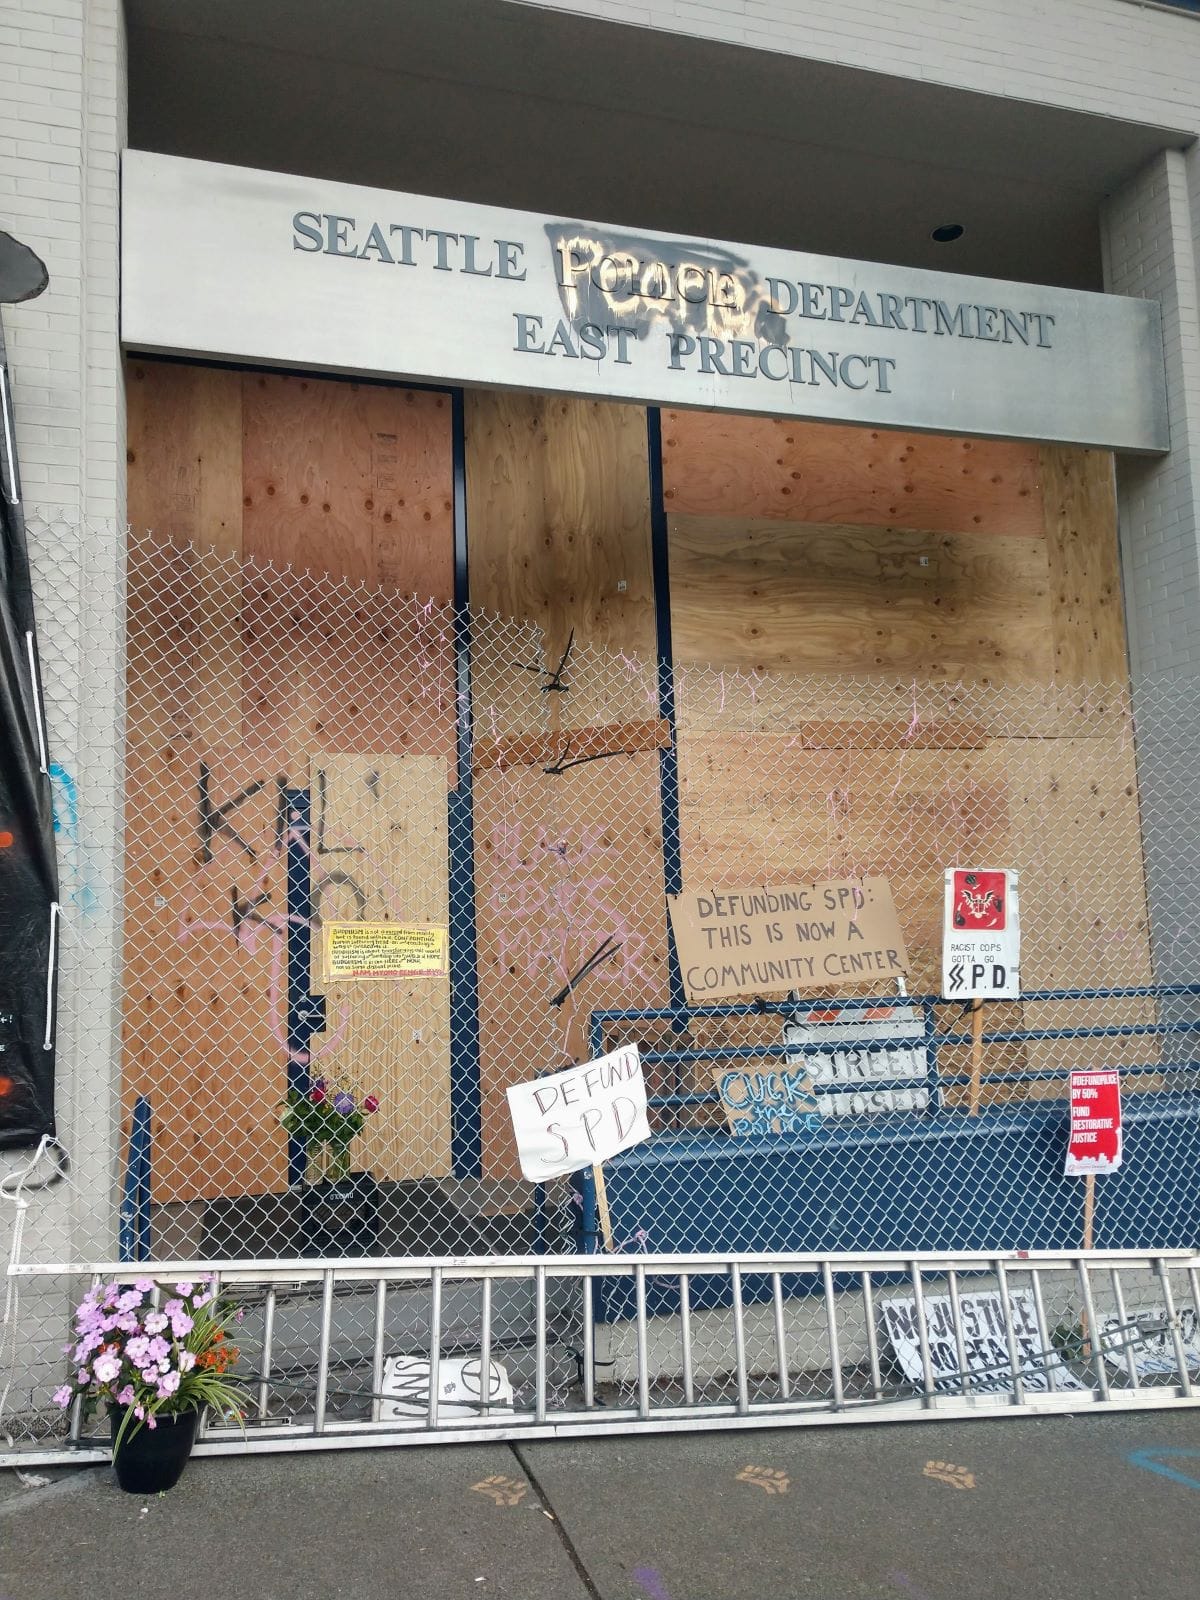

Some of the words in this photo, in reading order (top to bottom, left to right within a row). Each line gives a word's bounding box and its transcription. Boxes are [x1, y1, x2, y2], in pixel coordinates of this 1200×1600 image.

[293, 211, 528, 281] SEATTLE
[765, 277, 1056, 349] DEPARTMENT
[512, 312, 638, 365] EAST
[667, 333, 896, 394] PRECINCT
[696, 891, 813, 918] DEFUNDING
[823, 887, 875, 910] SPD:
[701, 923, 752, 949] THIS
[766, 922, 784, 943] IS
[796, 921, 835, 942] NOW
[847, 921, 864, 941] A
[950, 943, 976, 952] RACIST
[979, 943, 1002, 952] COPS
[686, 956, 815, 991] COMMUNITY
[823, 949, 902, 976] CENTER
[951, 955, 976, 963] GOTTA
[984, 955, 995, 963] GO
[533, 1052, 639, 1116] DEFUND
[1072, 1088, 1081, 1099] BY
[1082, 1087, 1098, 1099] 50%
[1073, 1106, 1090, 1117] FUND
[1073, 1118, 1114, 1130] RESTORATIVE
[540, 1096, 638, 1164] SPD
[1072, 1131, 1098, 1143] JUSTICE
[885, 1304, 930, 1340] NO
